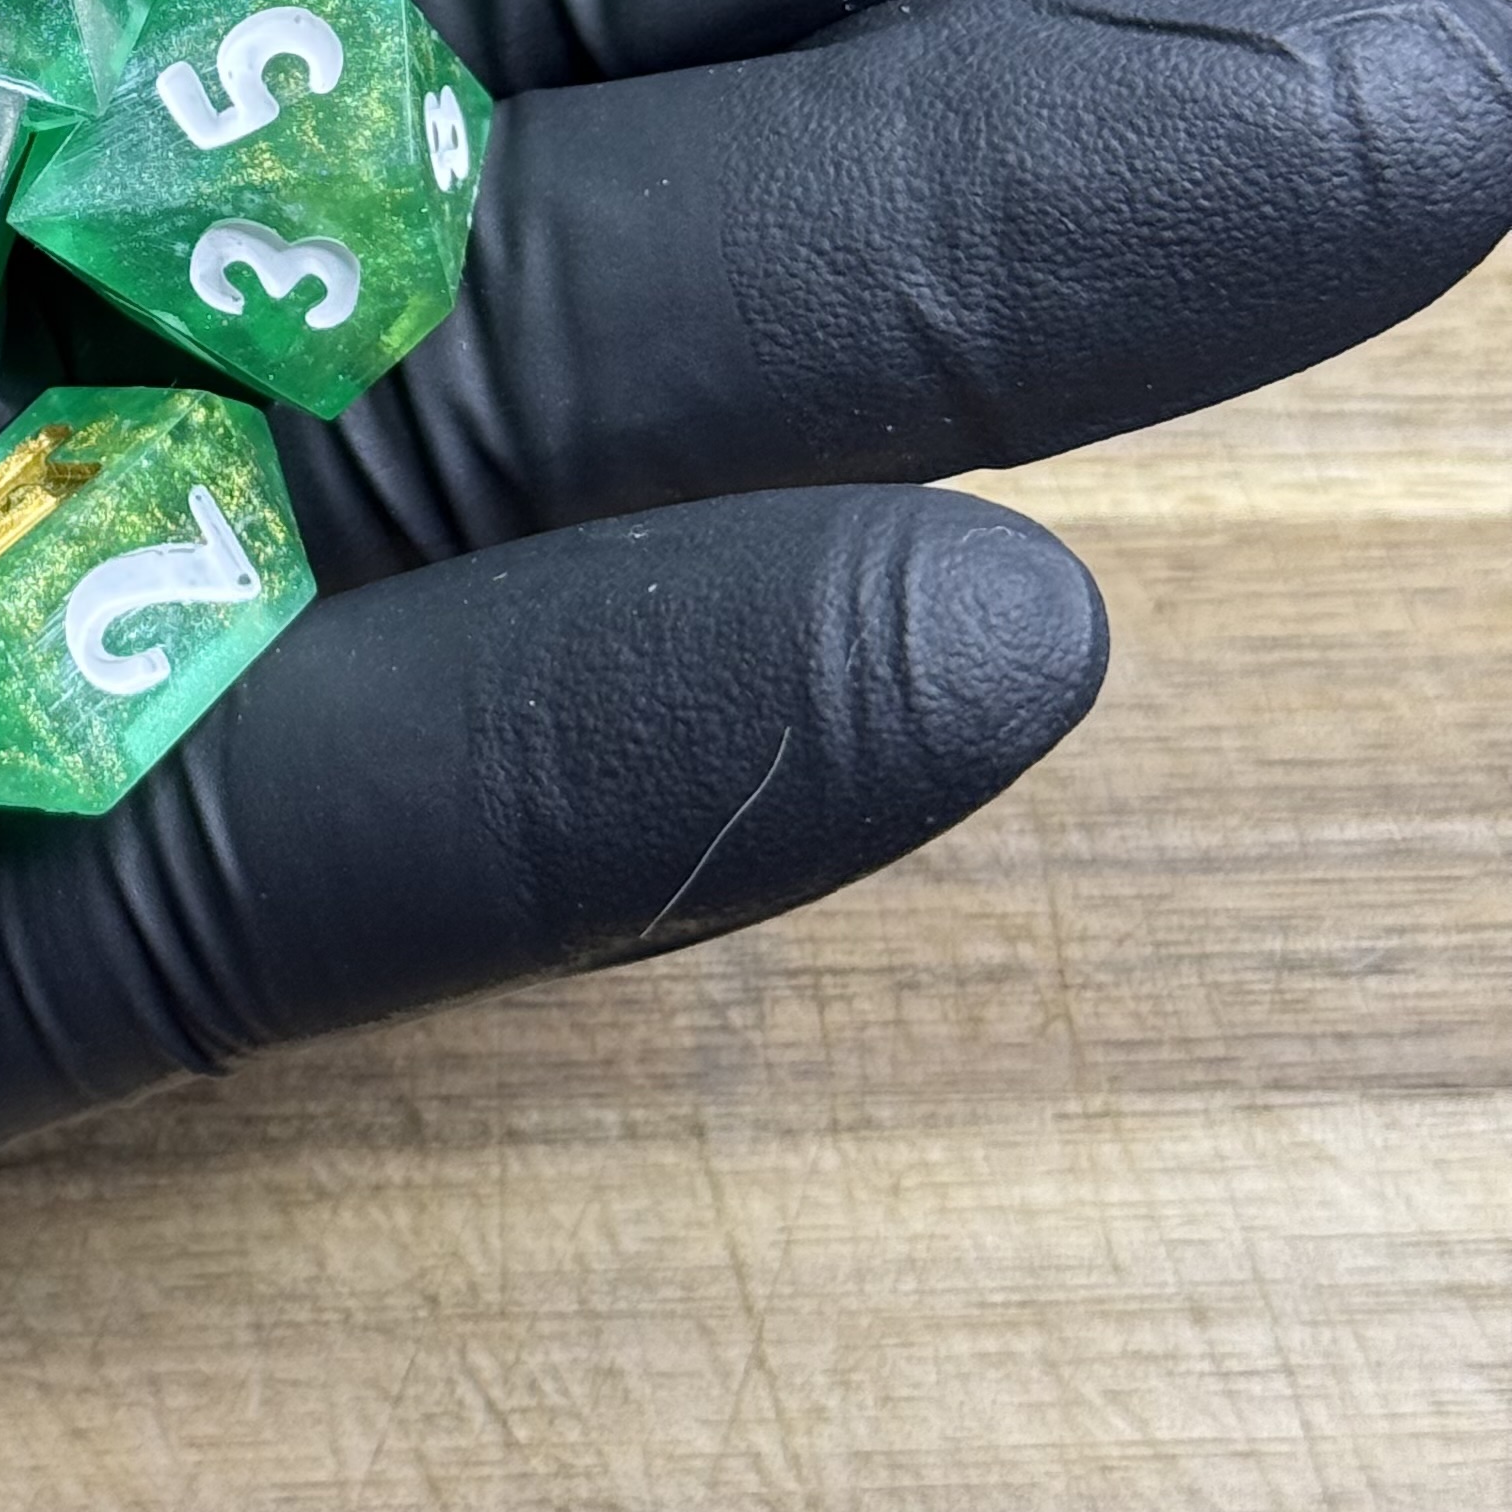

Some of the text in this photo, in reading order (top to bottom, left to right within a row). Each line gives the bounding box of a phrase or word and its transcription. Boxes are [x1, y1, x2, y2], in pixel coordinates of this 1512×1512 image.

[155, 6, 345, 151] 5
[424, 85, 471, 193] 8
[189, 218, 361, 330] 3
[65, 484, 263, 696] 2
